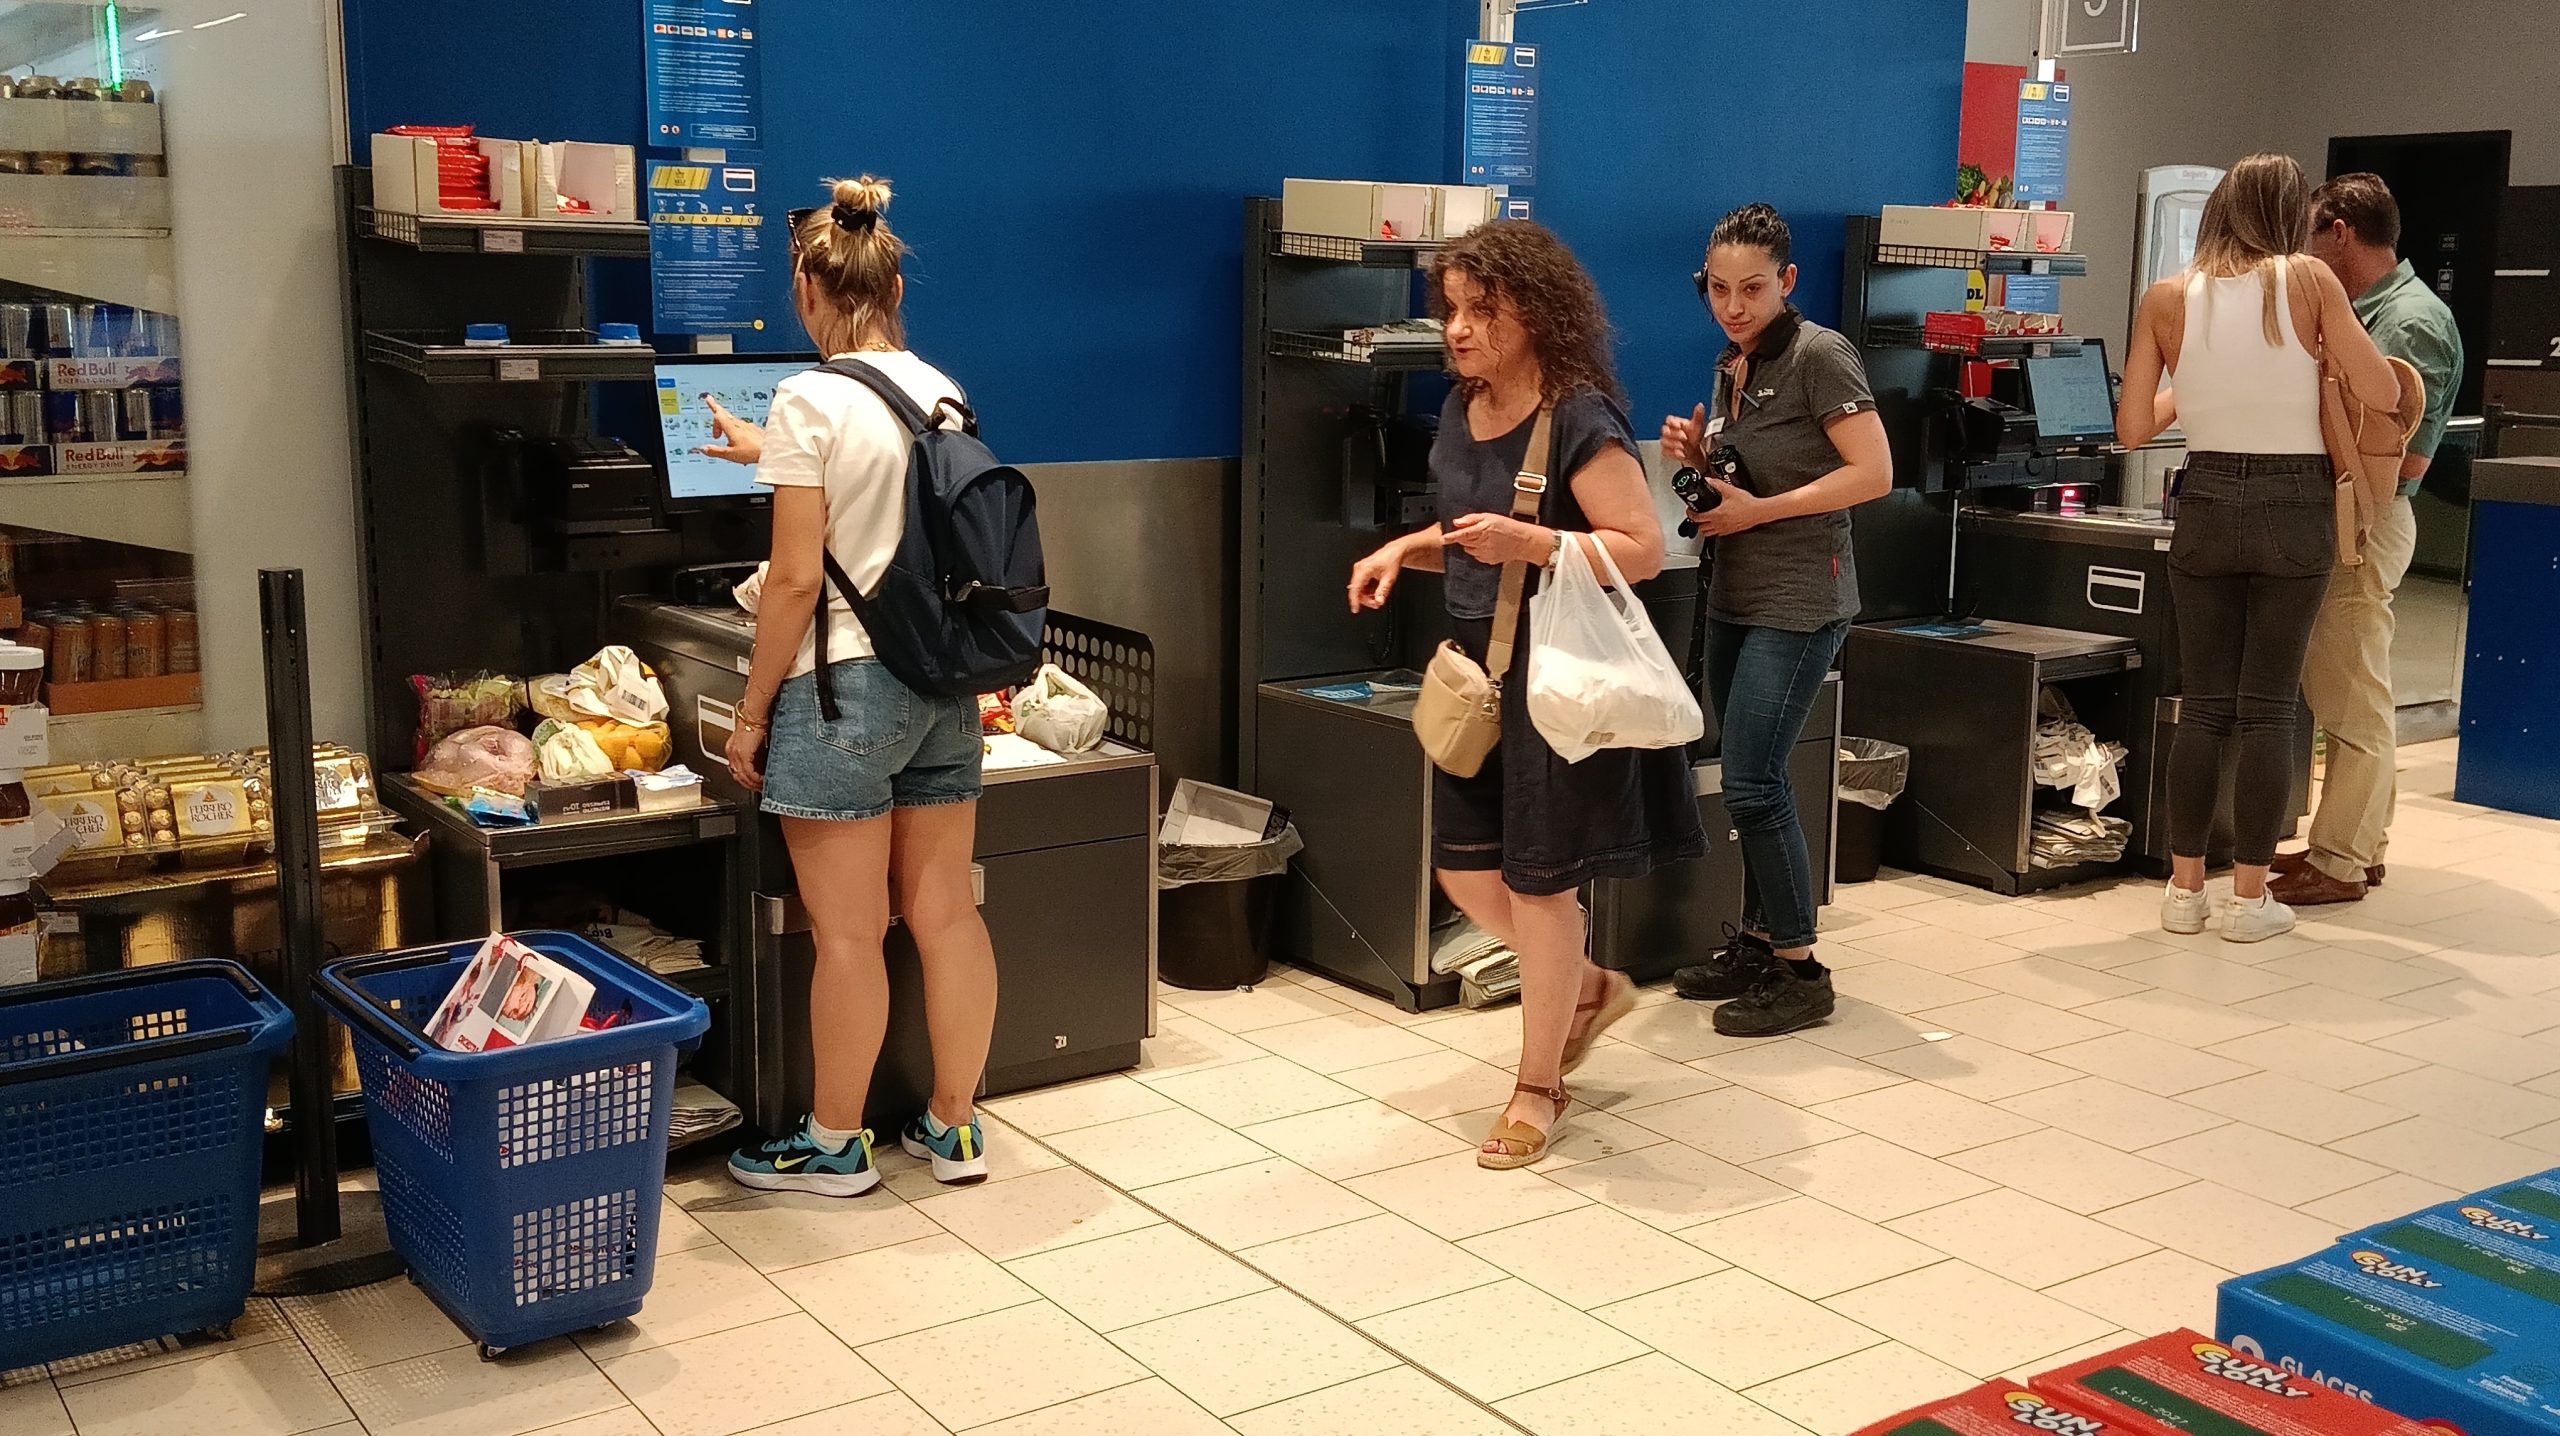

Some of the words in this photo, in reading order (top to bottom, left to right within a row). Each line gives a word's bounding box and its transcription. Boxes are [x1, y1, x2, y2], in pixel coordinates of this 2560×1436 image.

[1966, 288, 1984, 300] DL
[57, 363, 87, 377] Red
[88, 361, 117, 376] Bull
[65, 449, 94, 462] Red
[95, 446, 124, 461] Bull
[189, 802, 233, 814] FERRERO
[65, 815, 104, 827] ERRERO
[190, 811, 234, 824] ROCHER
[76, 824, 105, 835] CHER
[2464, 1210, 2535, 1231] SUN
[2471, 1219, 2550, 1240] LOLLY
[2356, 1254, 2428, 1278] SUN
[2360, 1266, 2443, 1288] LOLLY
[2200, 1351, 2289, 1382] SUN
[2203, 1364, 2310, 1397] LOLLY
[2008, 1399, 2103, 1432] SUN
